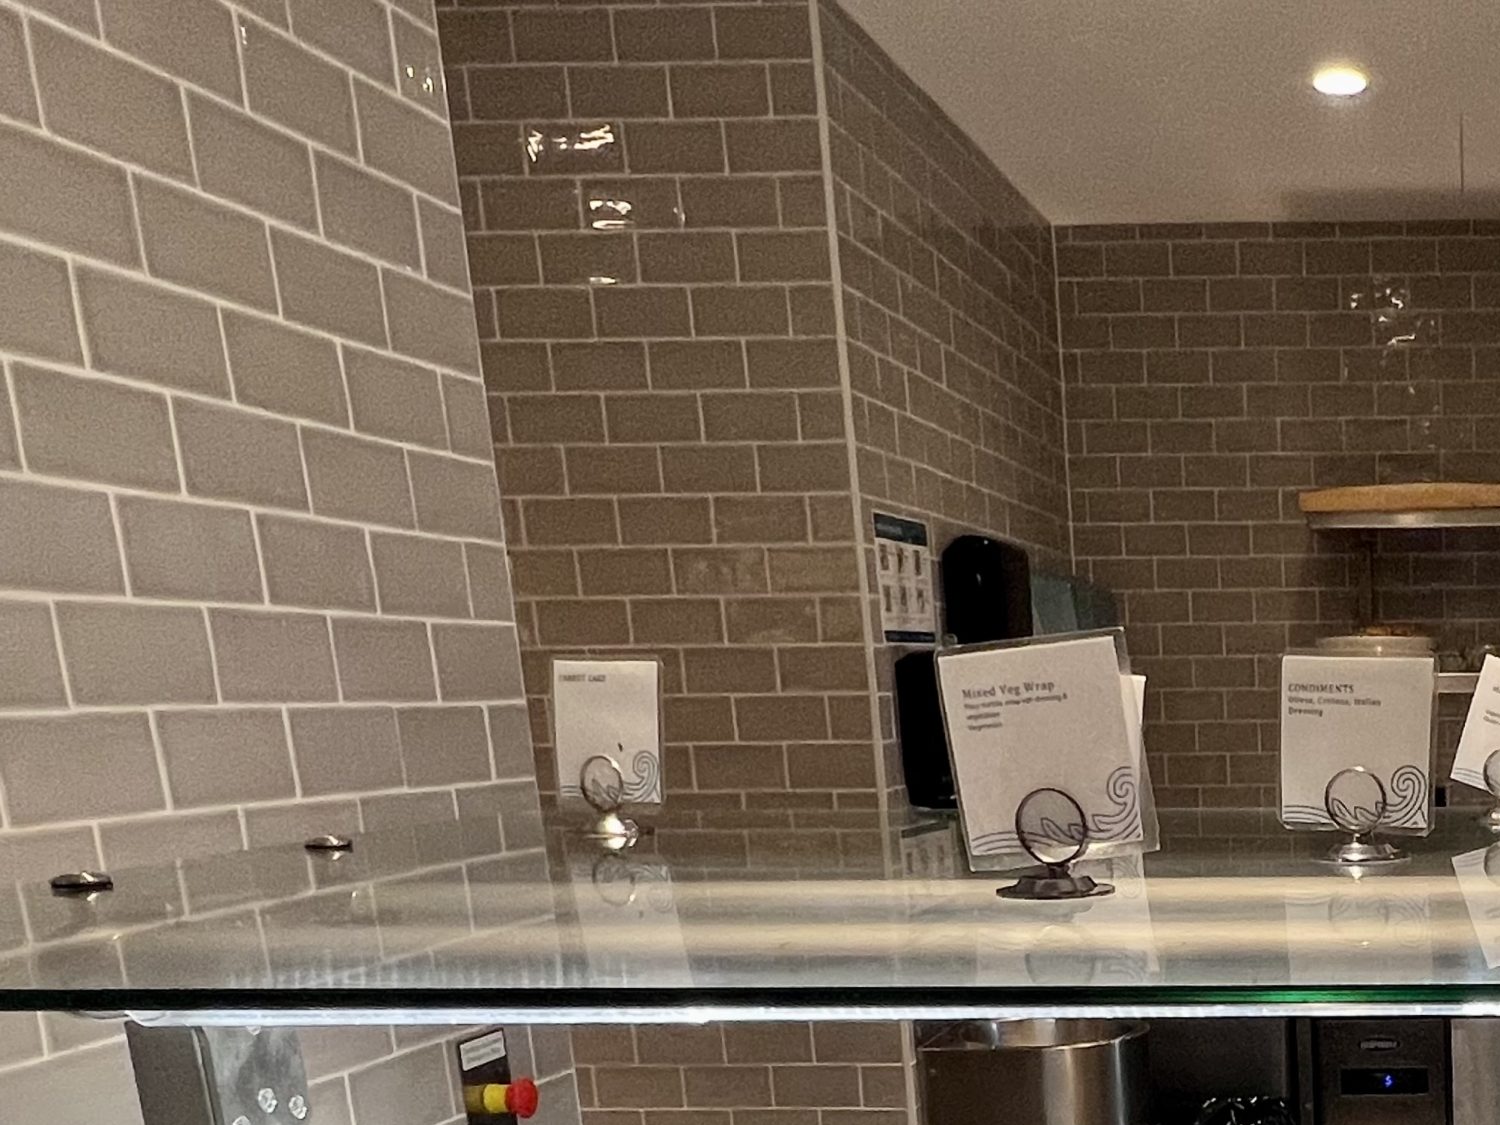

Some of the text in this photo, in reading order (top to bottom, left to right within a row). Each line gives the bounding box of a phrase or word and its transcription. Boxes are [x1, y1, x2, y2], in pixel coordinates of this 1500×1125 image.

[961, 680, 1056, 699] Mixed Veg Wrap
[1287, 683, 1354, 694] CONDIMENTS
